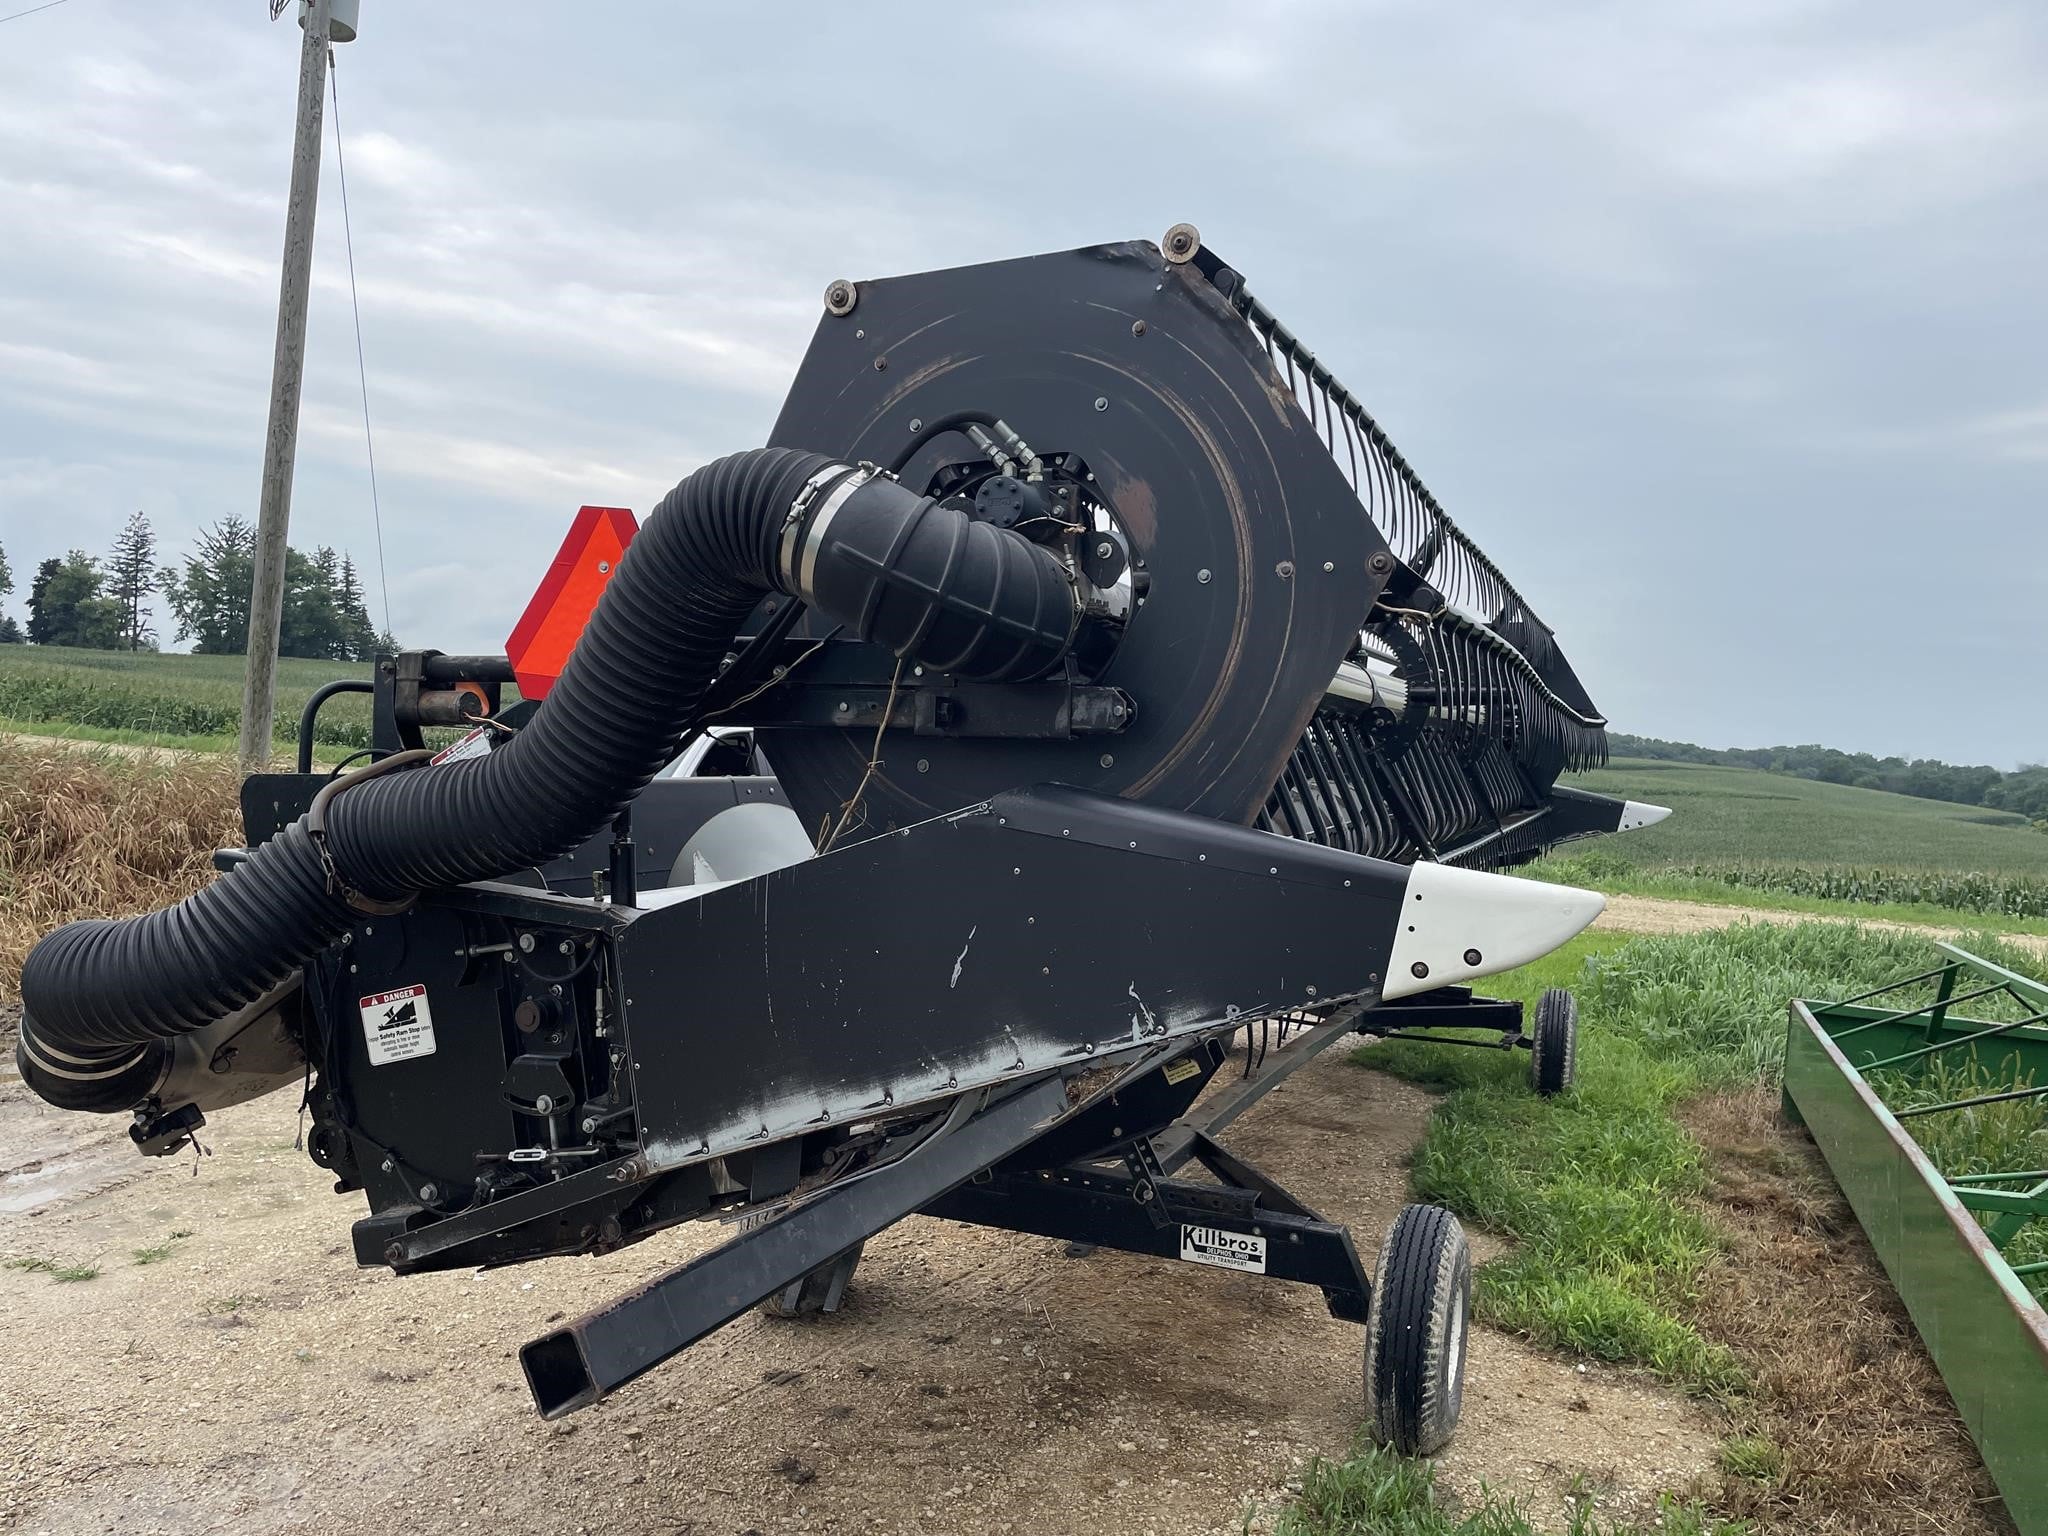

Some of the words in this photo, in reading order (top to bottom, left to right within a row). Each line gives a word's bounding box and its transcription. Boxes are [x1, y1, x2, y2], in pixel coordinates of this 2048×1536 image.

[383, 989, 415, 1003] DANGER
[379, 1032, 395, 1040] Safety
[1183, 1226, 1259, 1252] Killbros
[1197, 1253, 1217, 1262] UTILITY
[1217, 1256, 1247, 1267] TRANSPORT
[1206, 1247, 1234, 1259] DELPHOS,
[1235, 1252, 1249, 1261] OHIO
